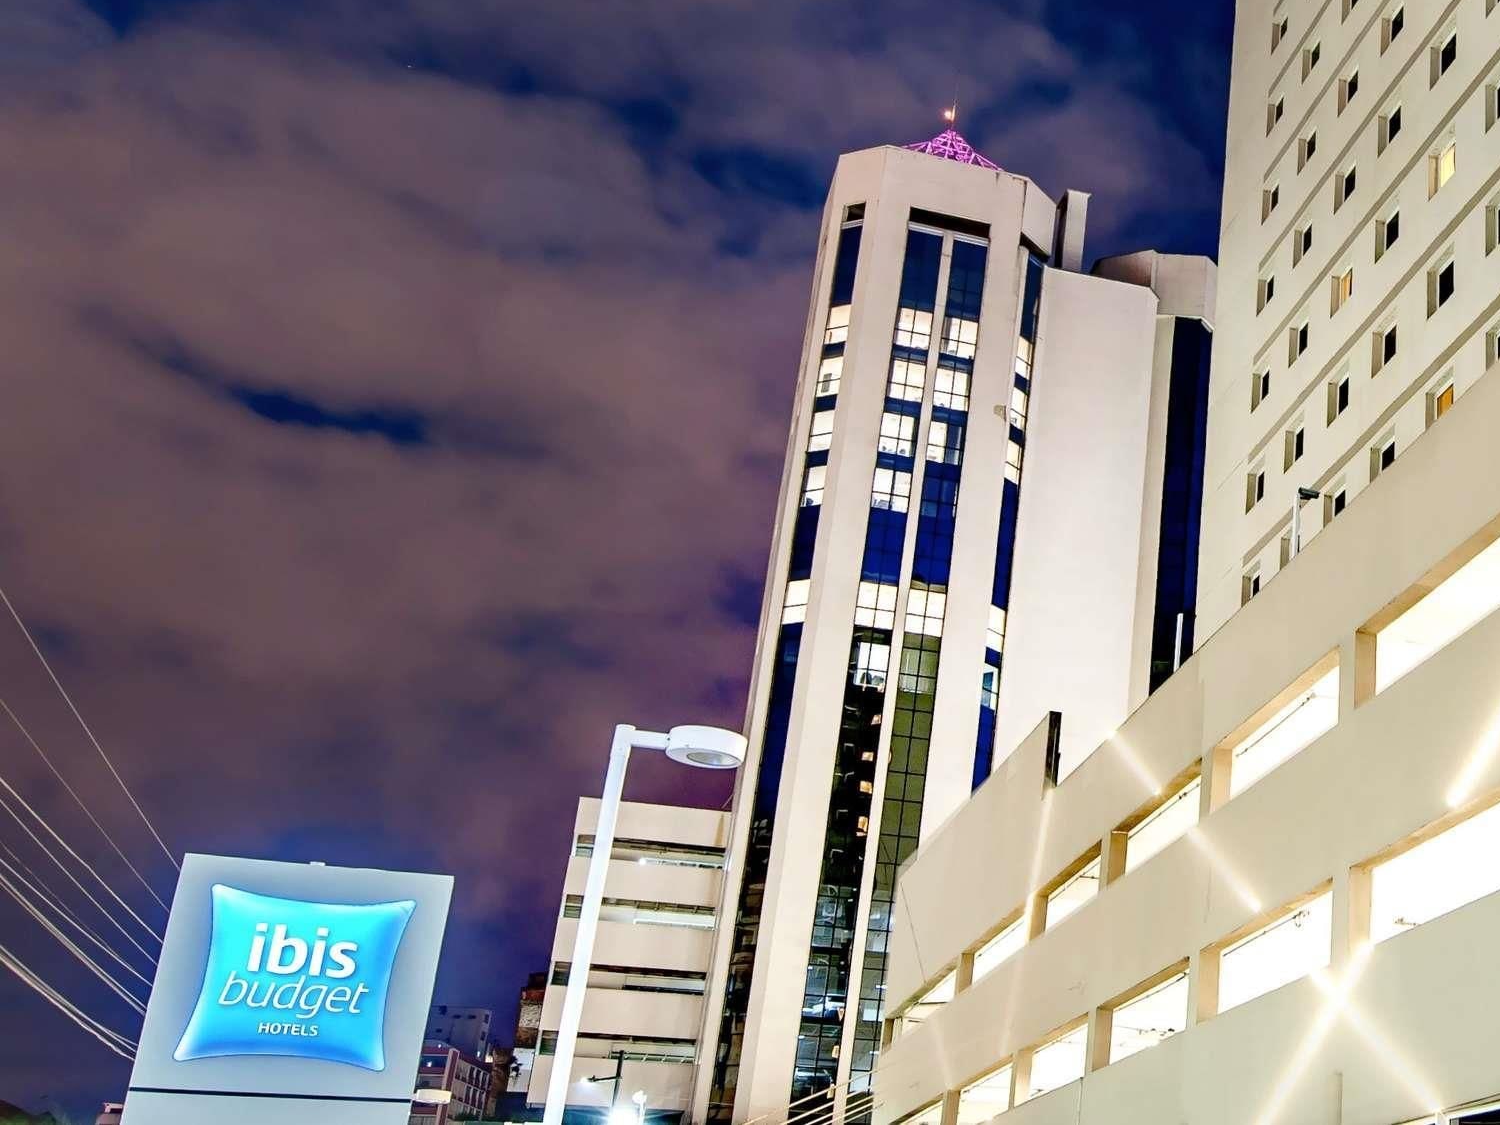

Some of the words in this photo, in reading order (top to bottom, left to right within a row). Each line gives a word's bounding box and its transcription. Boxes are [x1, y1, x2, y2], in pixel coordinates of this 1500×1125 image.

[247, 922, 359, 979] ibis
[218, 970, 369, 1018] budget
[257, 1021, 318, 1037] HOTELS
